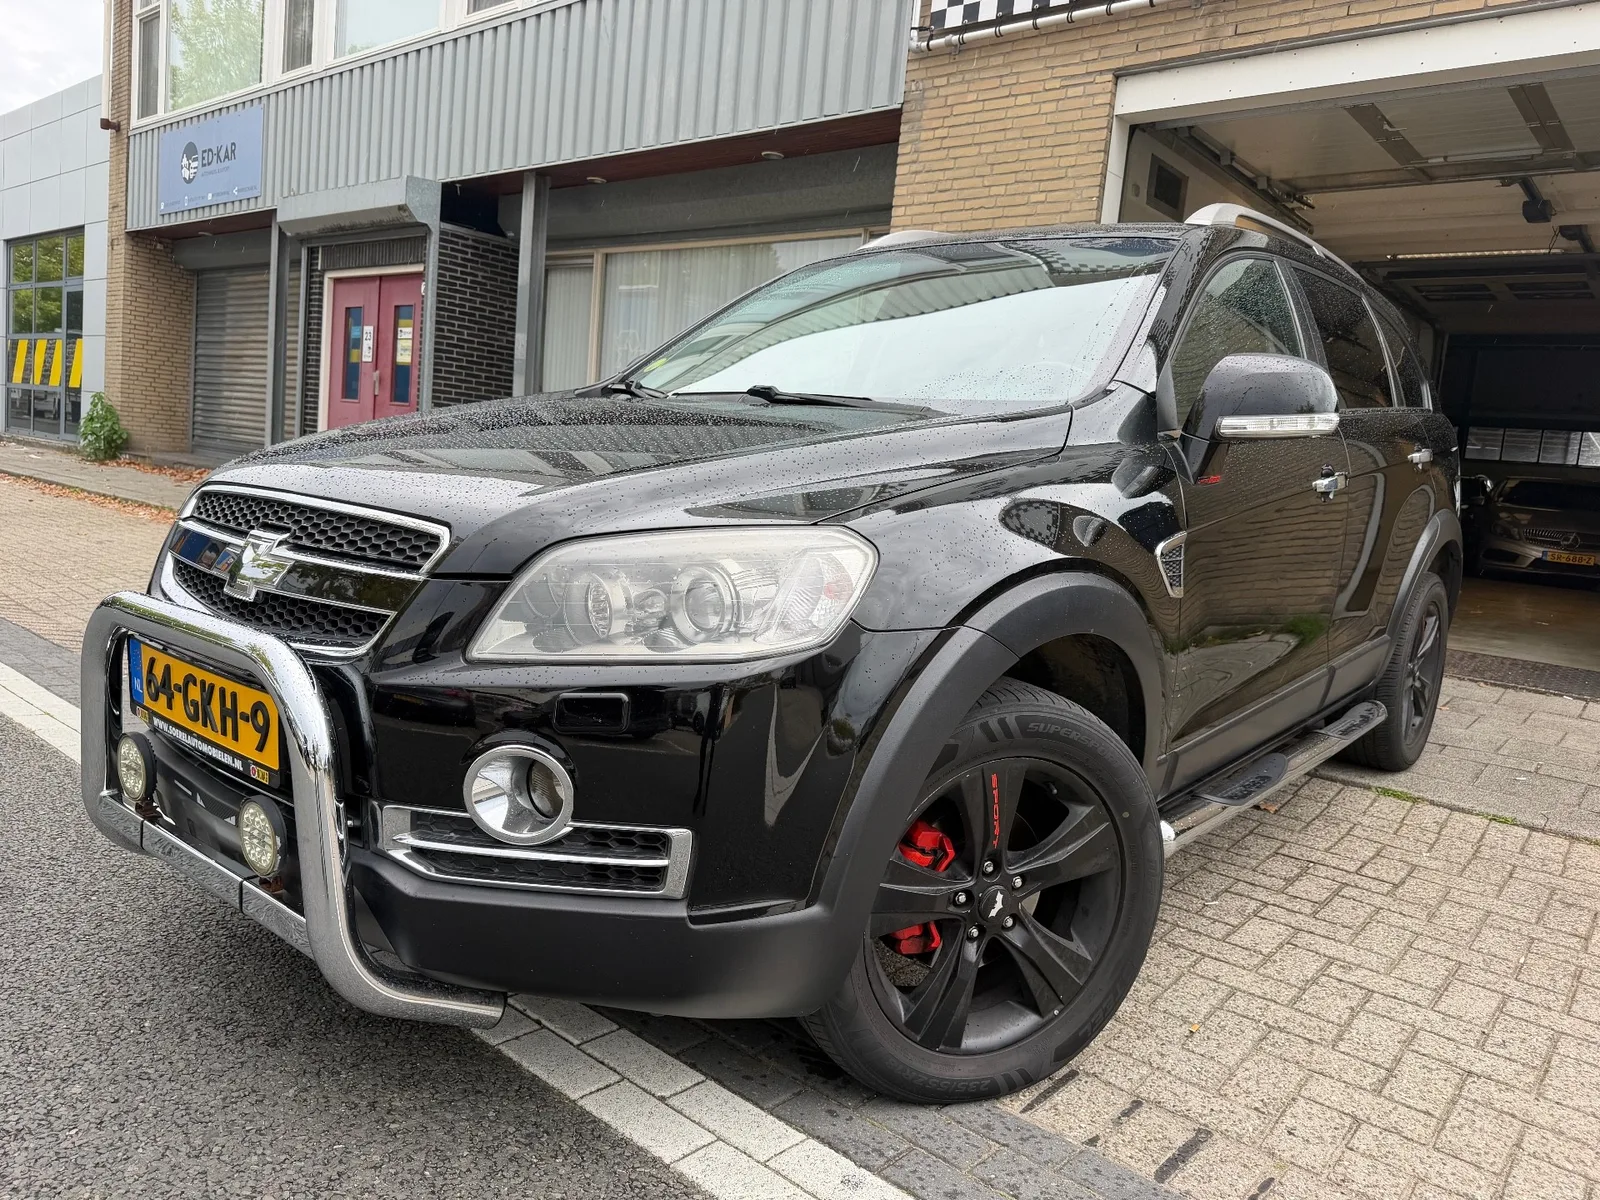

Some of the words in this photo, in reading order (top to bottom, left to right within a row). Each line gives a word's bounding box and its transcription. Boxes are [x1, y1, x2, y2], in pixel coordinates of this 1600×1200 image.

[201, 142, 236, 168] ED-KAR
[364, 331, 372, 341] 23
[1550, 553, 1592, 564] SR-688-Z
[134, 677, 143, 693] NL
[145, 656, 270, 753] 64-GKH-9
[152, 716, 244, 772] WWW.SOERELAUTOMOBIELEN.NL
[991, 773, 1000, 849] SPORT
